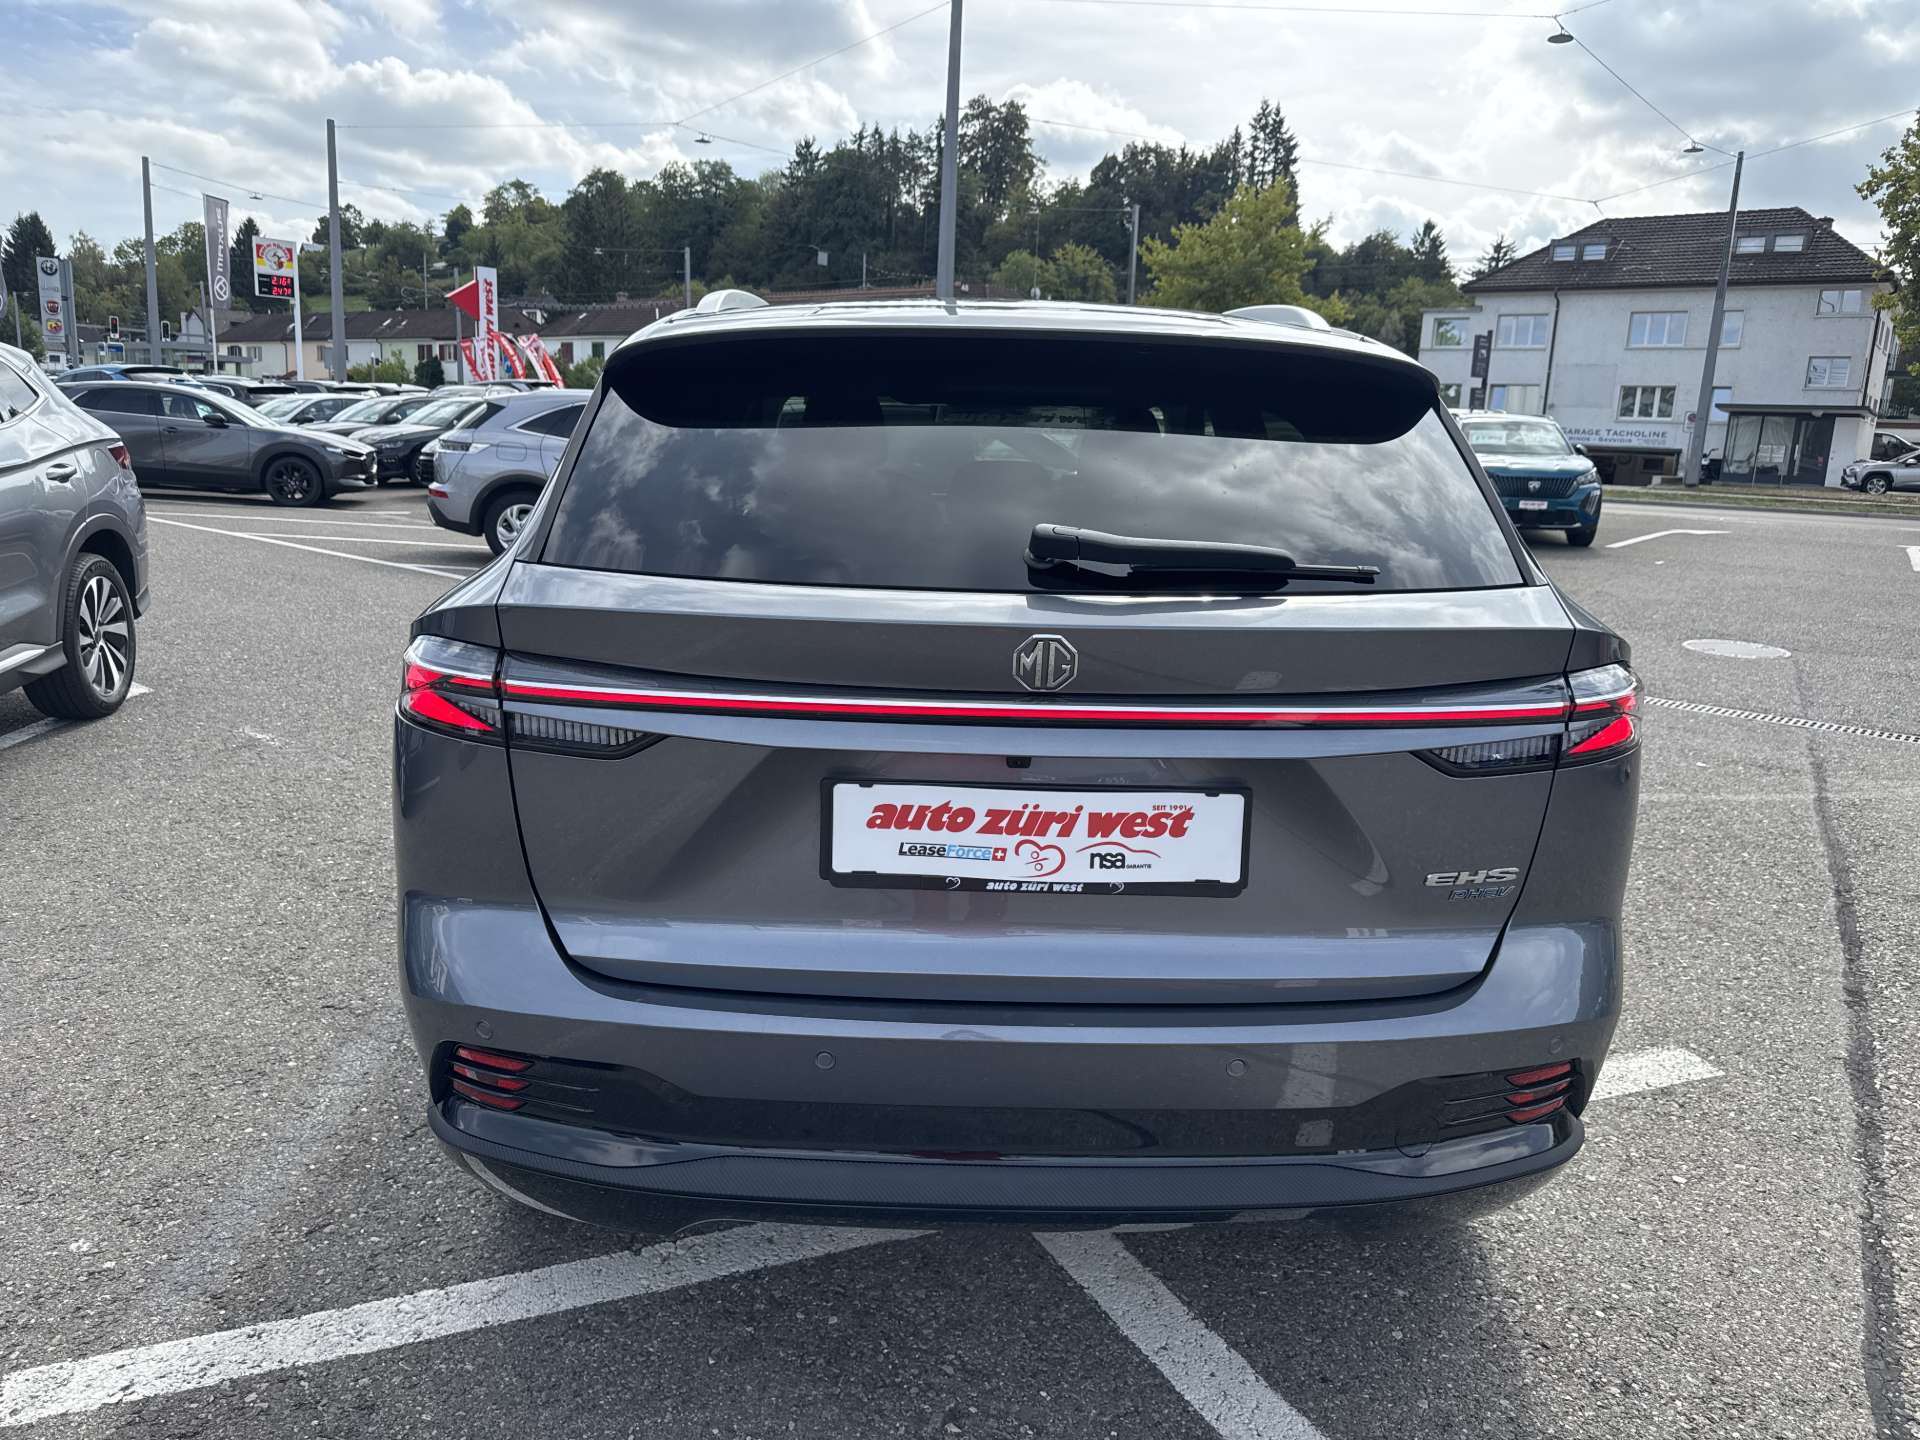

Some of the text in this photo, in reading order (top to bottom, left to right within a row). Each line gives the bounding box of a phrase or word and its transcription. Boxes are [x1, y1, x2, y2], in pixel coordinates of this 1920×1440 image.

[1606, 429, 1668, 439] TACHOLINE
[1020, 641, 1071, 688] MG
[866, 800, 1195, 838] auto züri west
[898, 842, 992, 860] LeaseForce
[1089, 852, 1125, 869] nsa
[1424, 867, 1520, 886] EHS
[986, 881, 1084, 892] auto züri west
[1448, 885, 1516, 901] PHEV
